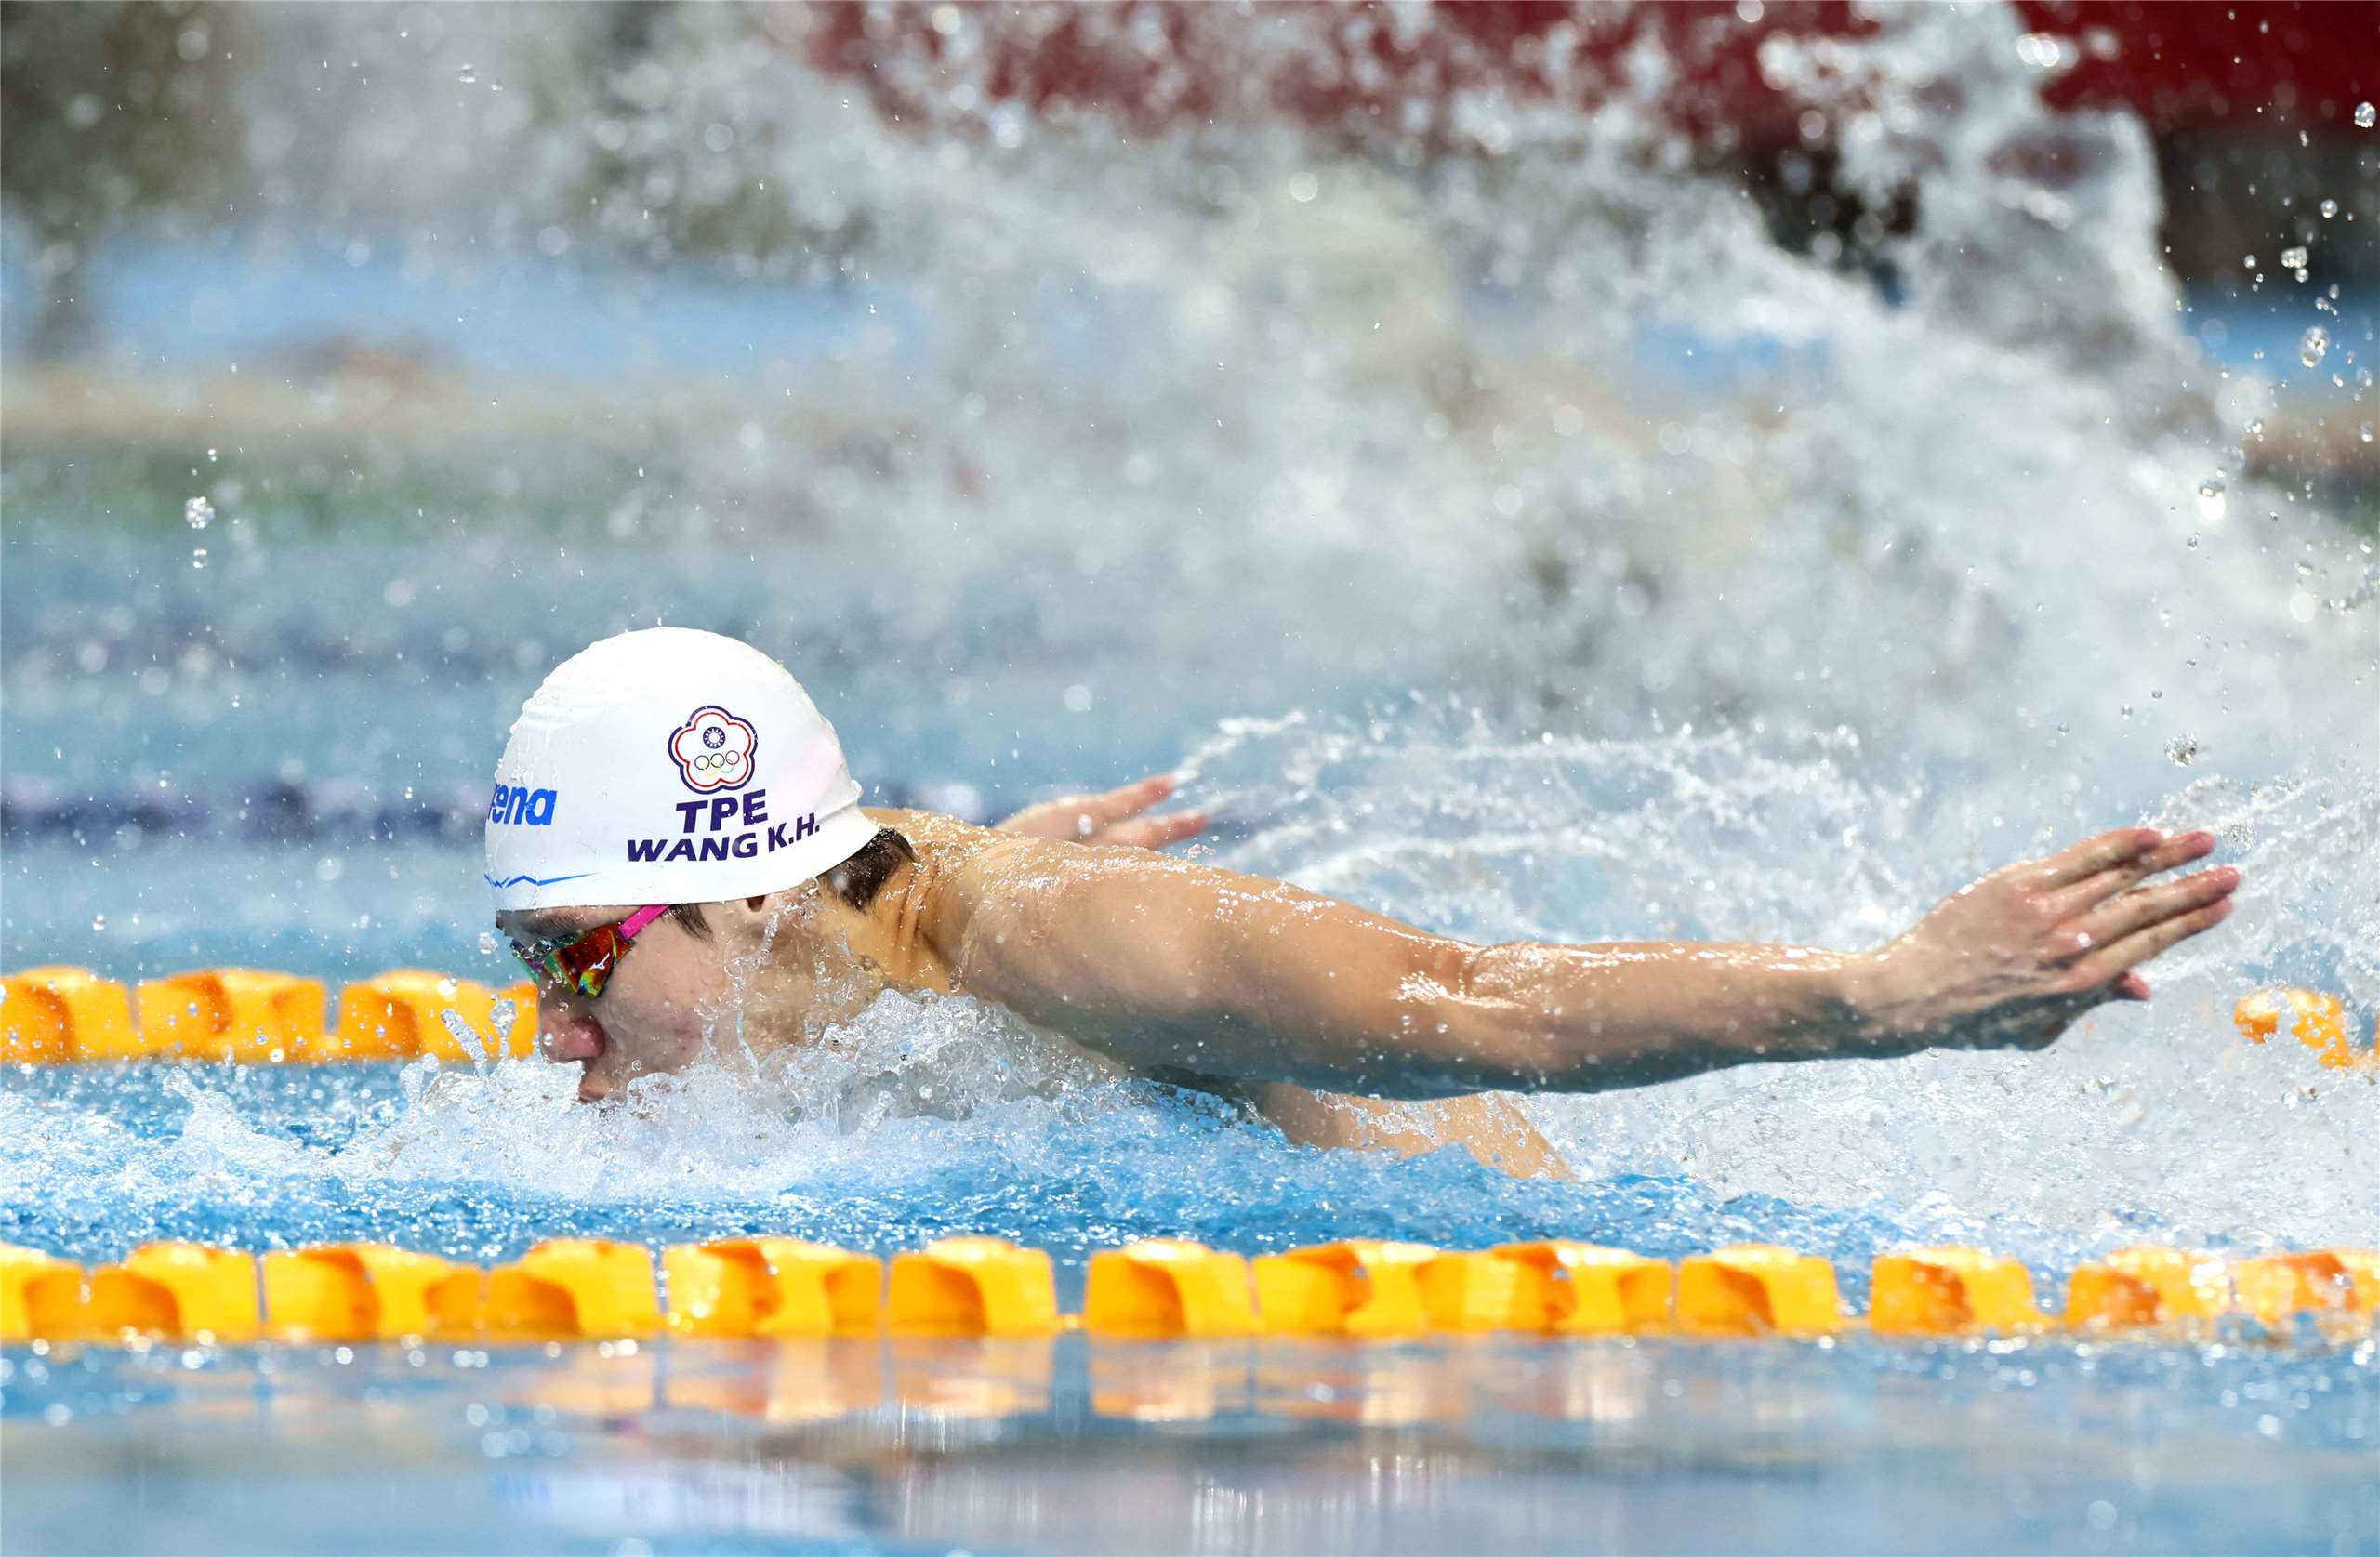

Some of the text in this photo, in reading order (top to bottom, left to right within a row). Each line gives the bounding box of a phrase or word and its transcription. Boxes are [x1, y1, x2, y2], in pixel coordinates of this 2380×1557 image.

[676, 789, 768, 834] TPE
[627, 812, 820, 862] WANG K.H.
